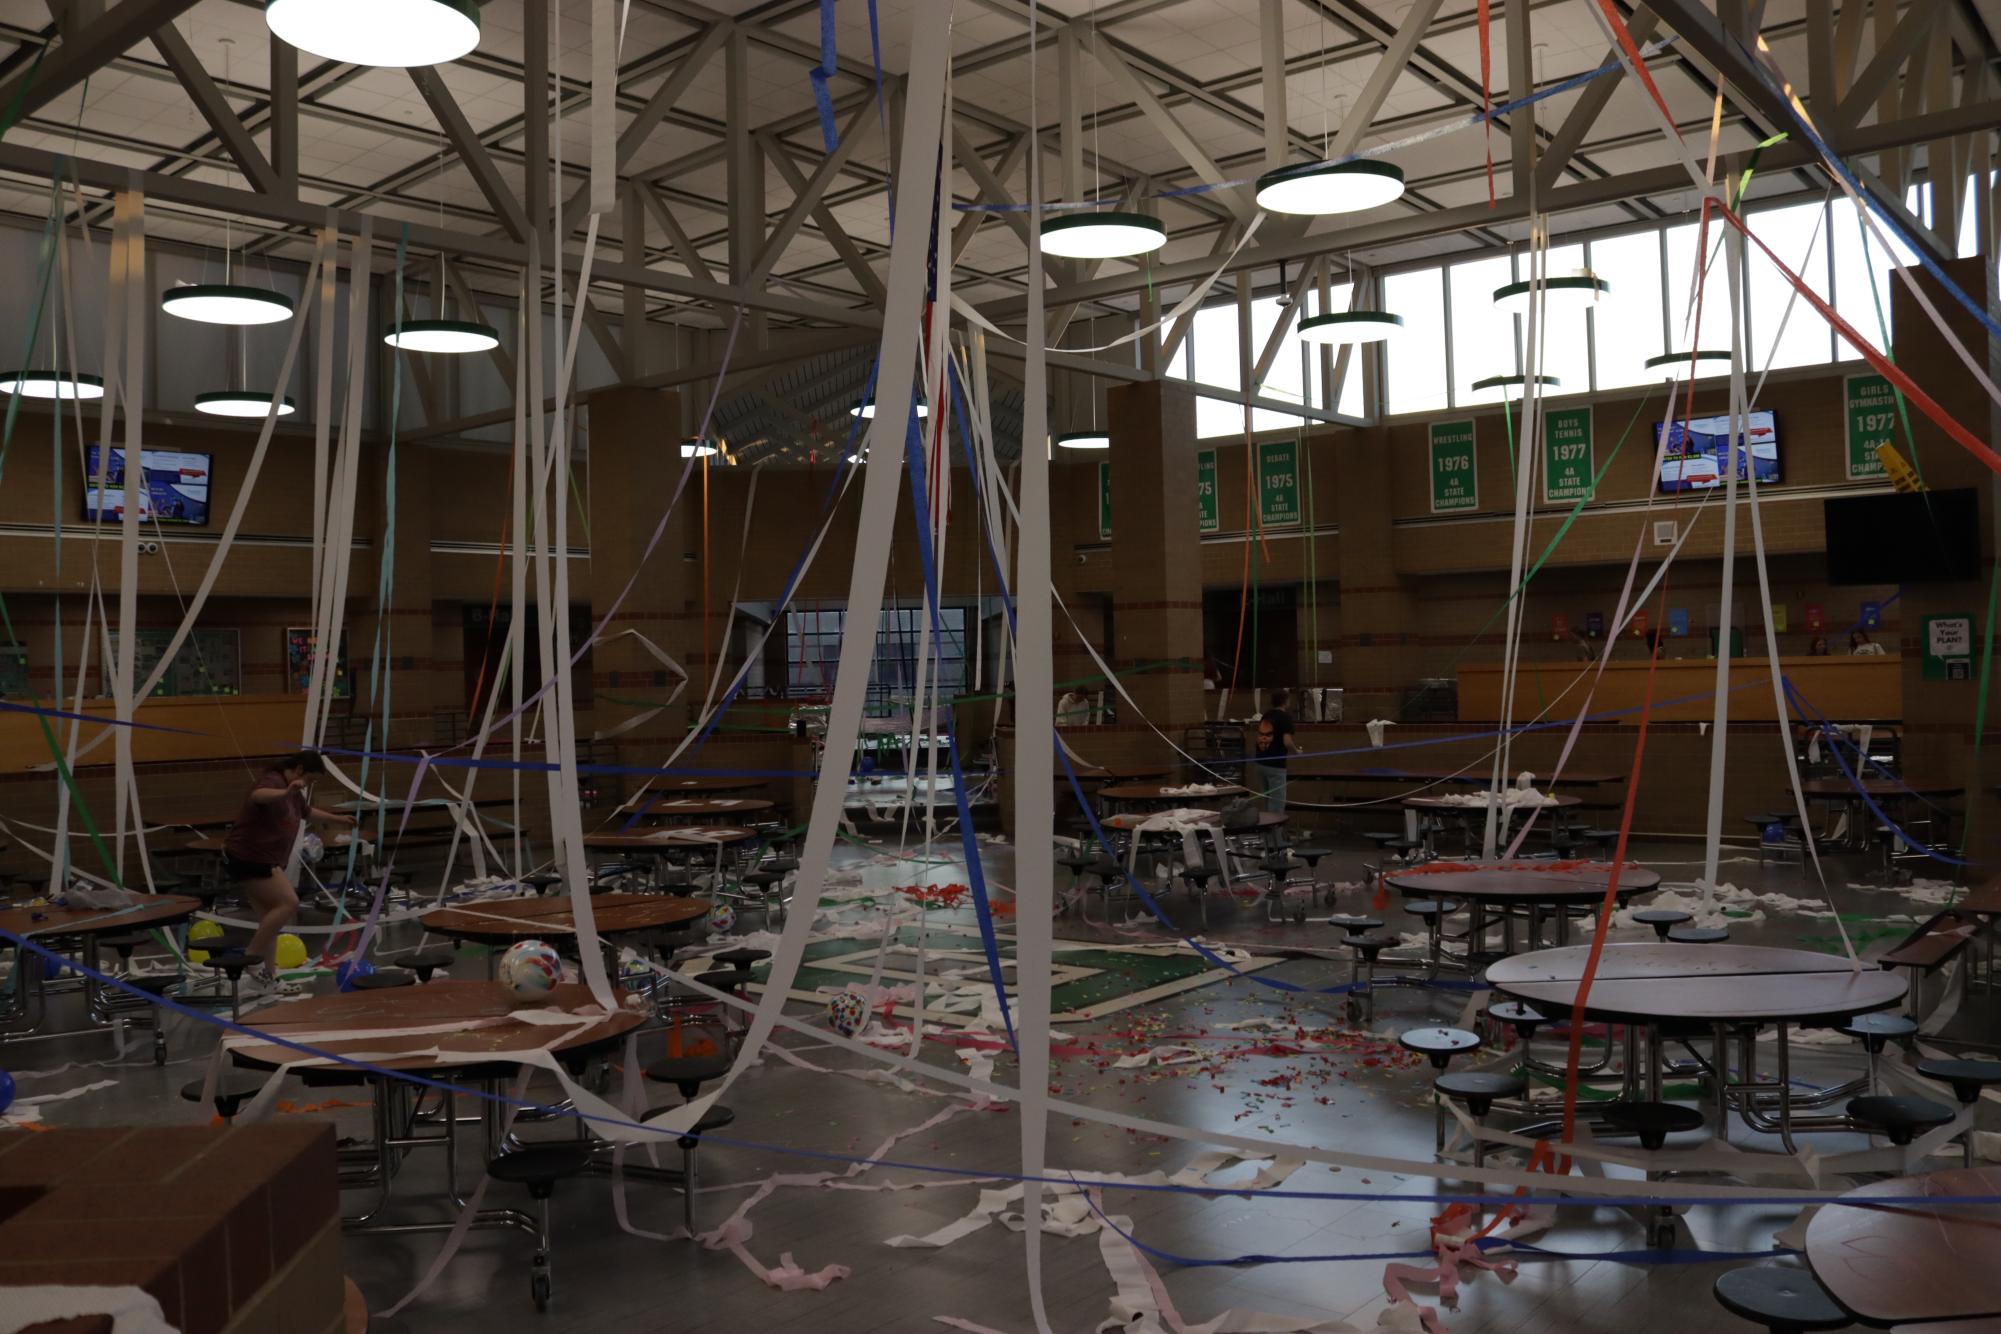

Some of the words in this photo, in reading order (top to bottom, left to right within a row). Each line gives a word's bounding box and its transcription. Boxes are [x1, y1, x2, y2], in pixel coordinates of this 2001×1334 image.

[1860, 384, 1889, 396] GIRLS
[1557, 418, 1579, 428] BOYS
[1857, 413, 1894, 432] 1977
[1433, 432, 1473, 444] WRESTLING
[1554, 428, 1583, 439] TENNIS
[1553, 443, 1586, 461] 1977
[1266, 453, 1289, 463] DEBATE
[1438, 455, 1470, 472] 1976
[1564, 467, 1575, 476] 4A
[1852, 462, 1884, 474] CHAMP
[1266, 474, 1293, 489] 1975
[1449, 477, 1459, 486] 4A
[1558, 477, 1581, 487] STATE
[1199, 481, 1213, 495] 75
[1443, 487, 1465, 497] STATE
[1548, 487, 1587, 497] CHAMPION
[1435, 496, 1475, 507] CHAMPIONS
[1271, 503, 1288, 512] STATE
[1263, 512, 1298, 521] CHAMPIONS
